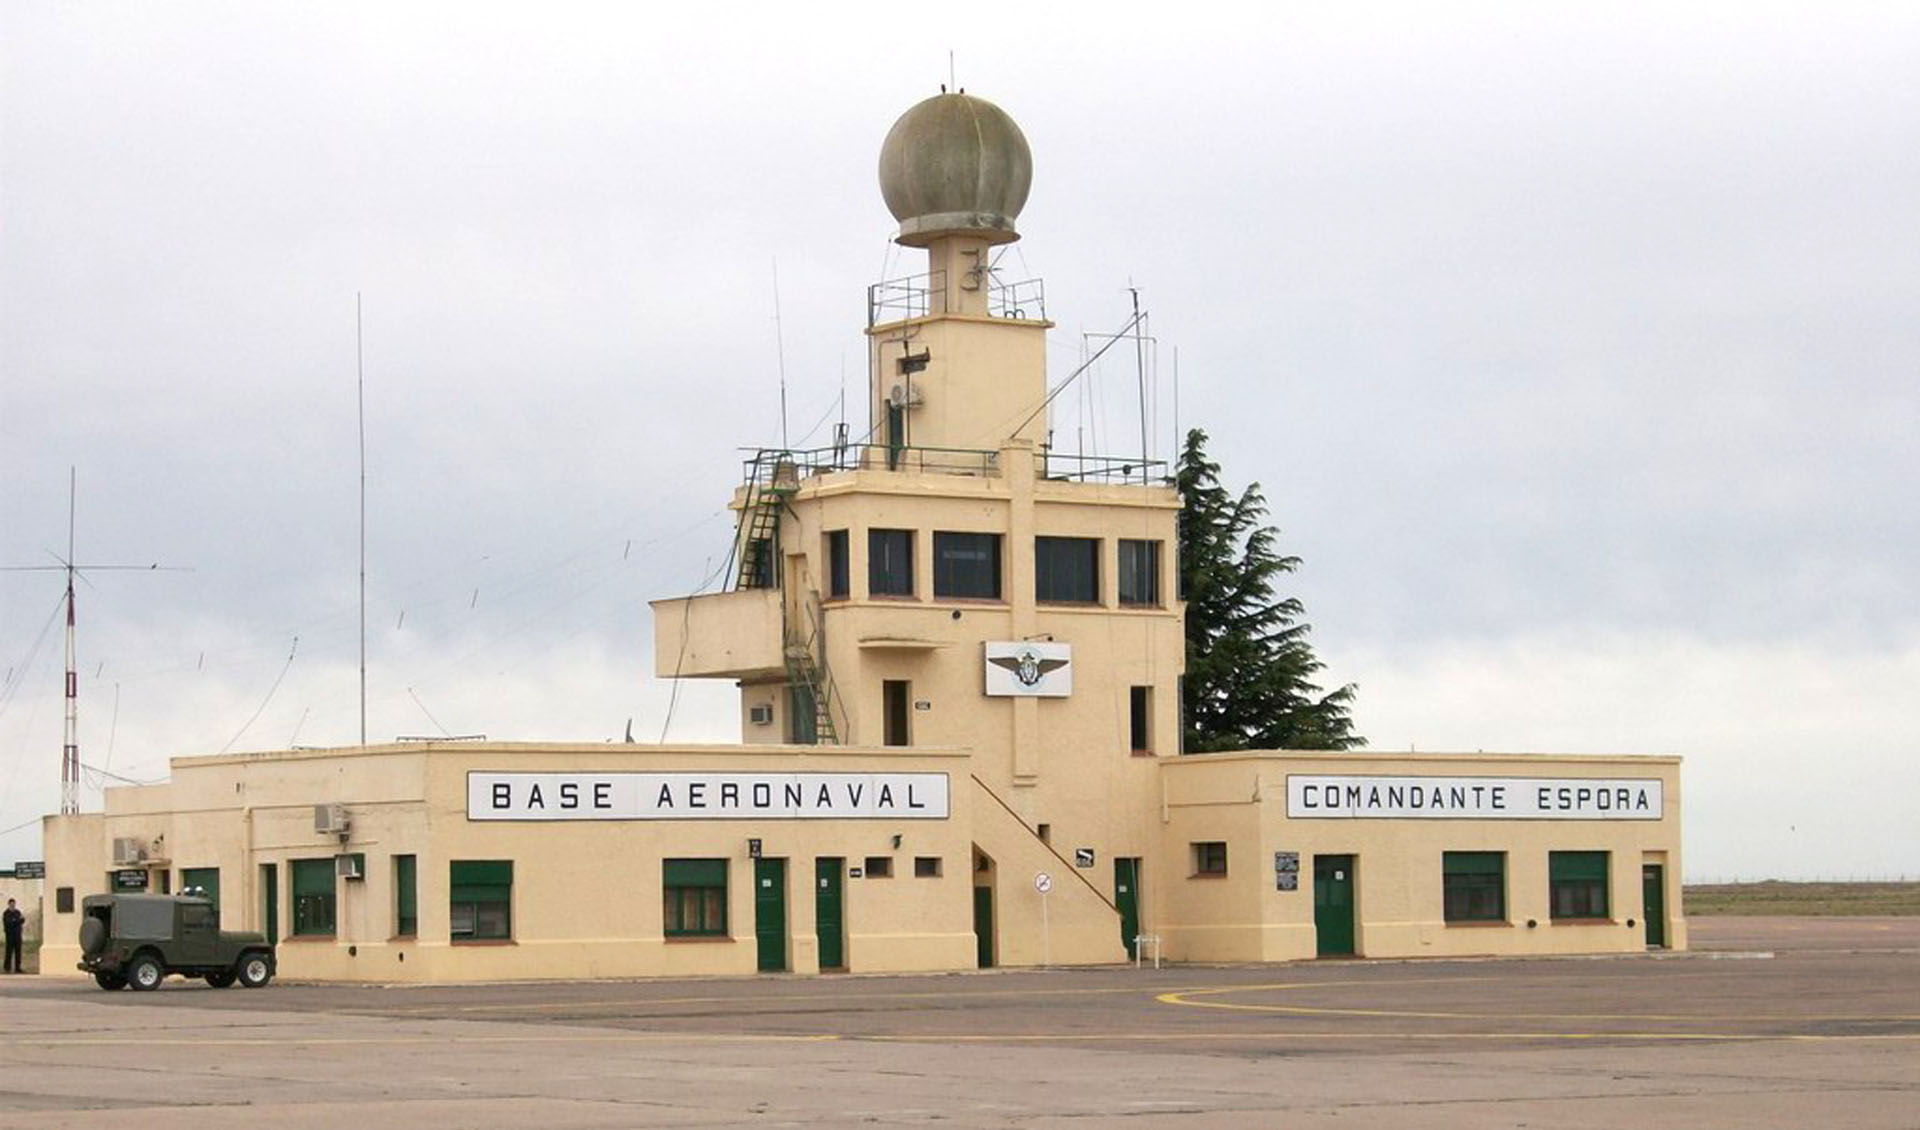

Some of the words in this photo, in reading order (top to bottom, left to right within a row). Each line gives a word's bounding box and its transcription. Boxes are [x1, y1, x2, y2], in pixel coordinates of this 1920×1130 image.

[492, 783, 612, 809] BASE
[657, 783, 925, 808] AERONAVAL
[1303, 785, 1505, 809] COMANDANTE
[1538, 787, 1650, 810] ESPORA
